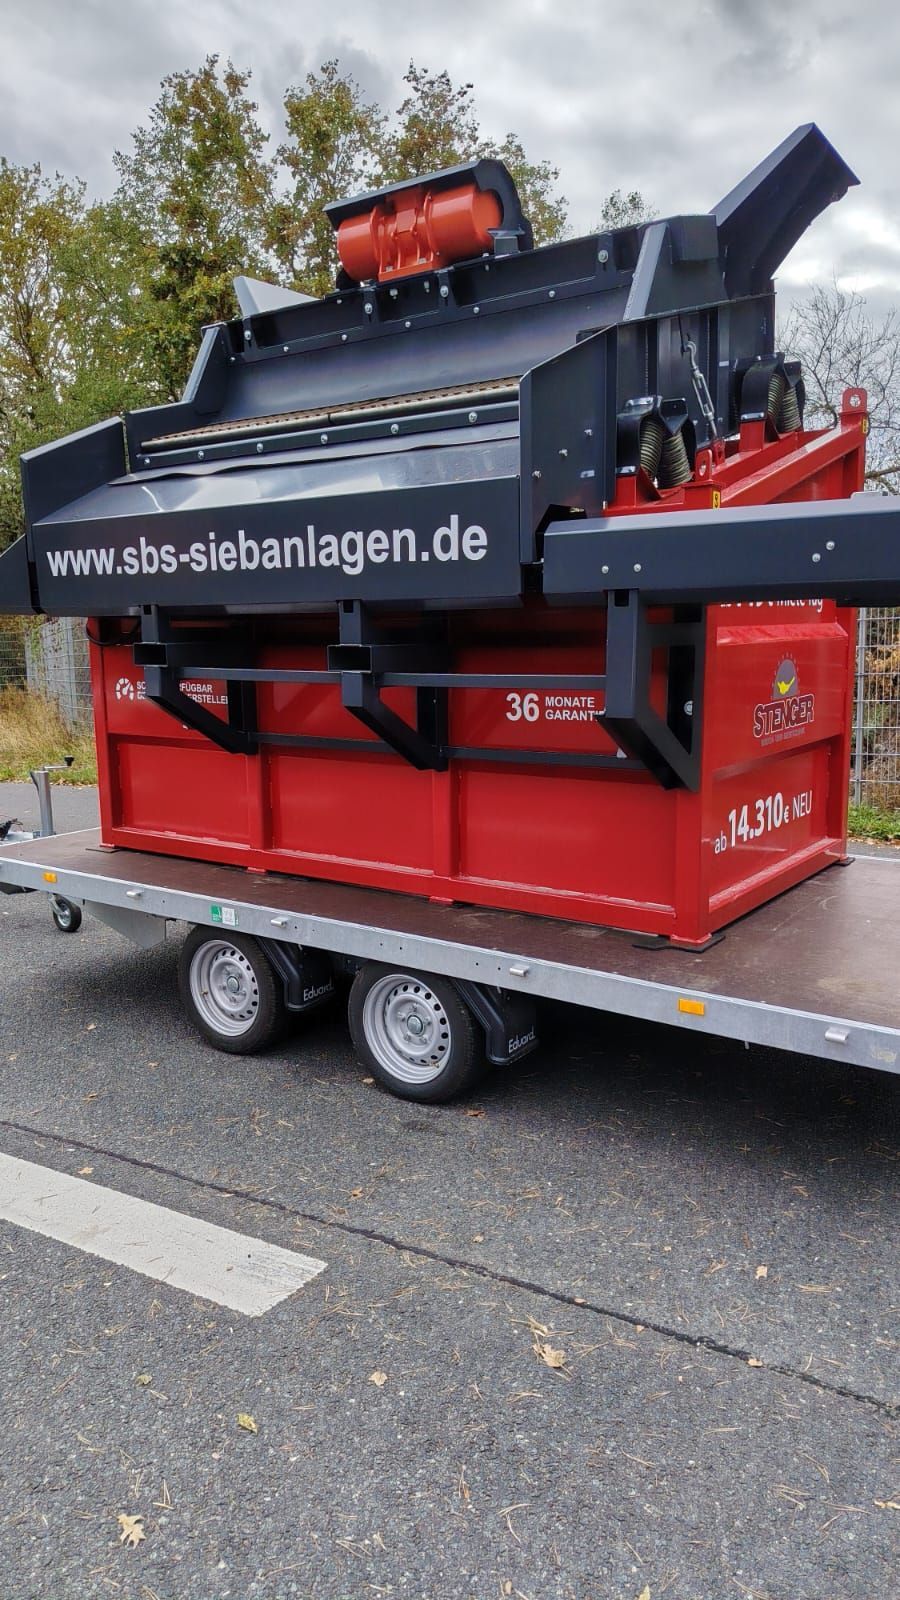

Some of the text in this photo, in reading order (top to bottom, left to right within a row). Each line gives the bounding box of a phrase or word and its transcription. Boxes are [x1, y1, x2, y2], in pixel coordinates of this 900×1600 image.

[46, 514, 489, 577] www.sbs-siebanlagen.de
[179, 682, 213, 692] FÜGBAR
[545, 696, 595, 707] MONATE
[505, 692, 541, 722] 36
[753, 693, 815, 738] STENGER
[714, 830, 727, 854] ab
[792, 790, 813, 820] NEU
